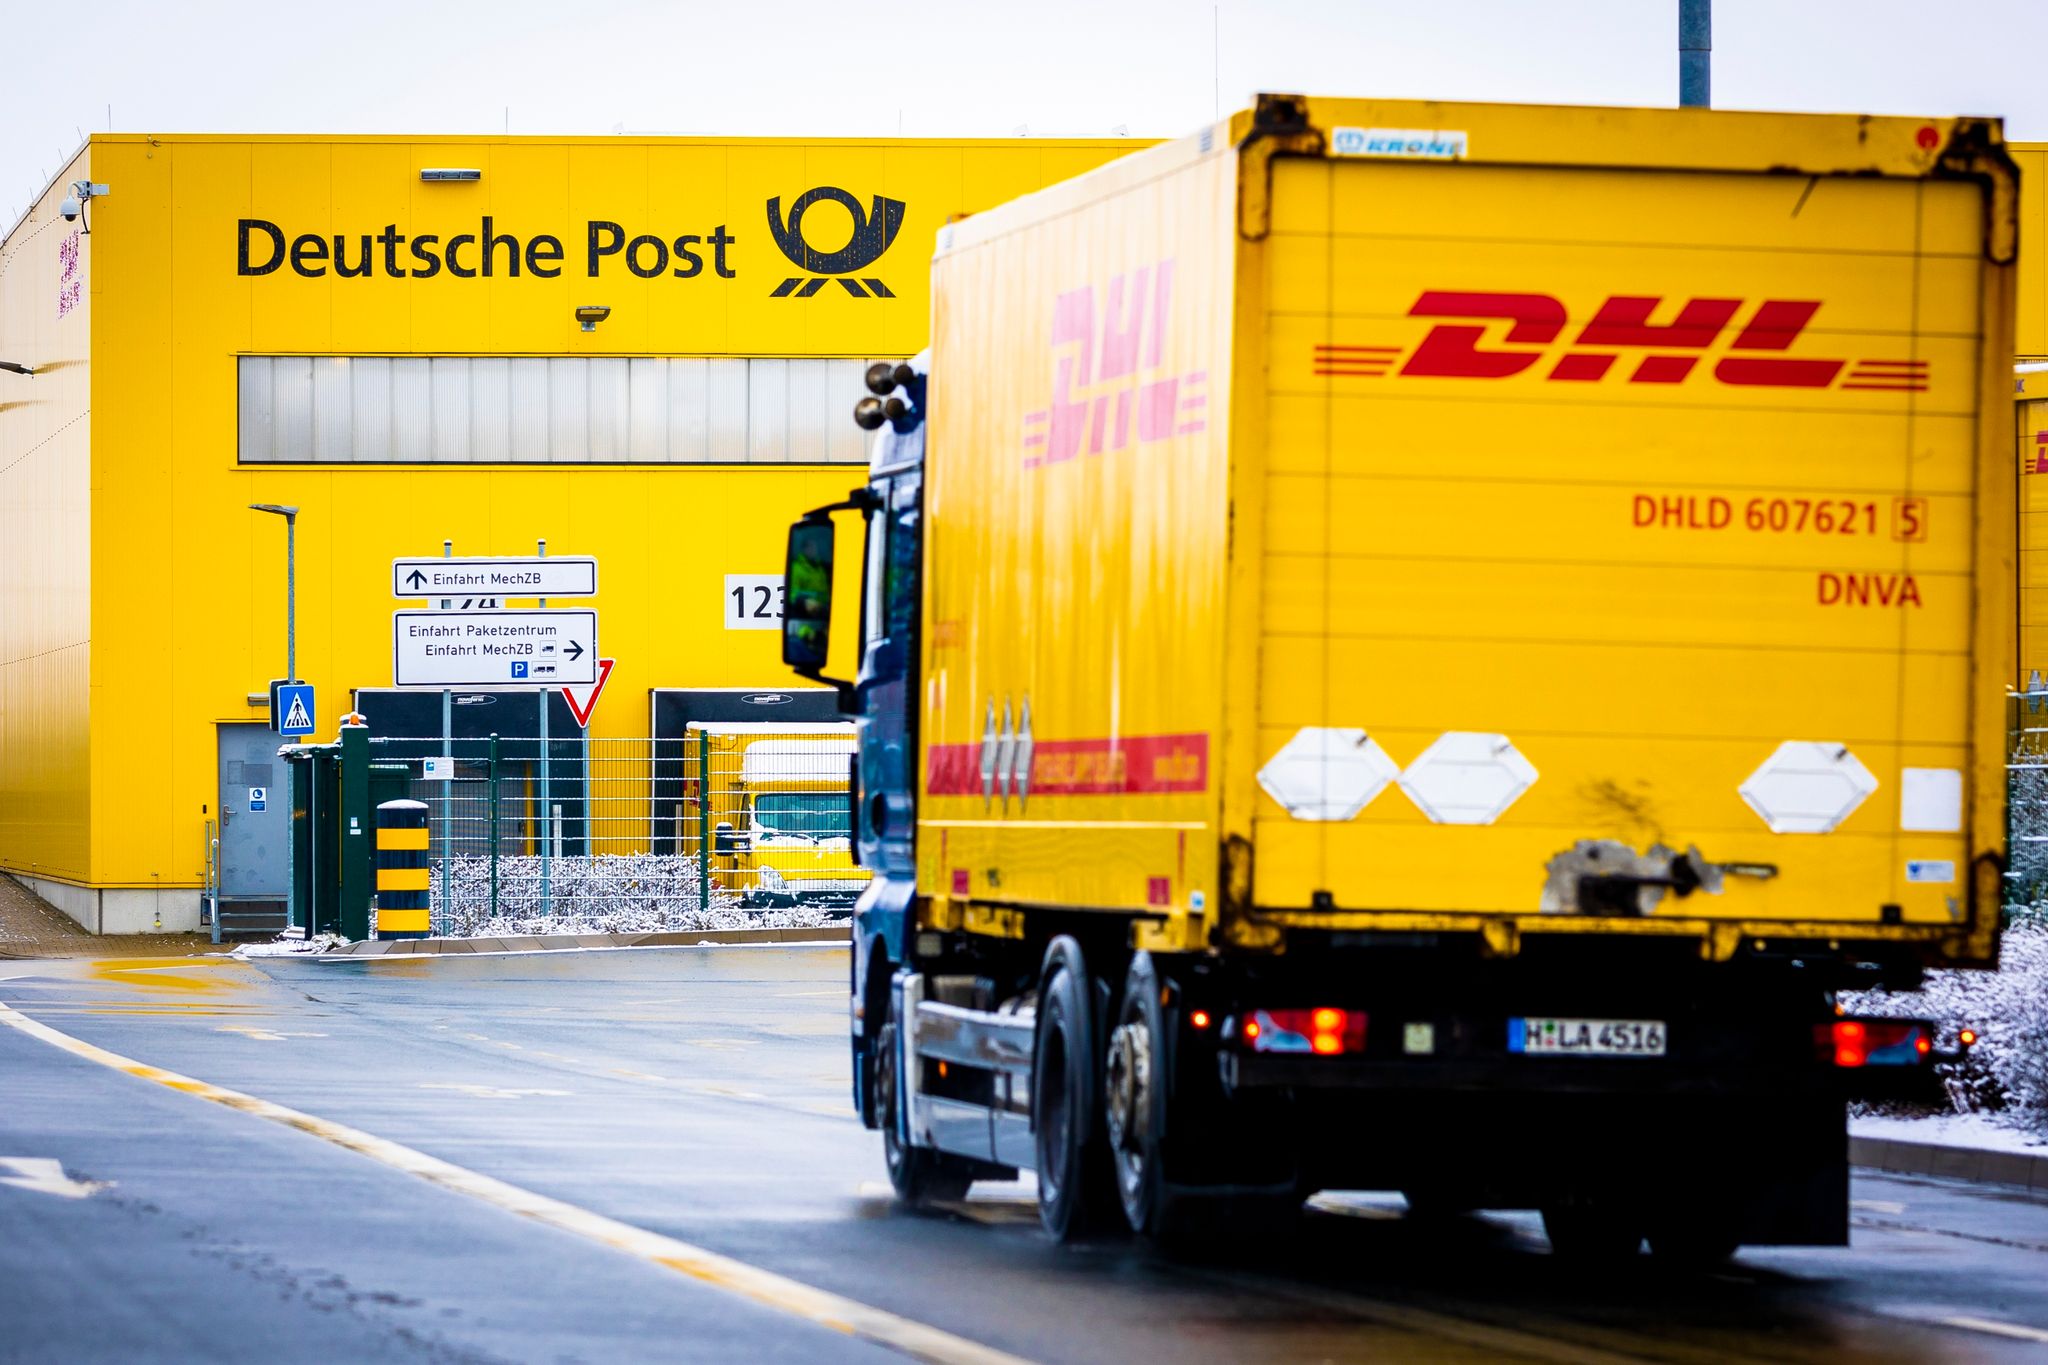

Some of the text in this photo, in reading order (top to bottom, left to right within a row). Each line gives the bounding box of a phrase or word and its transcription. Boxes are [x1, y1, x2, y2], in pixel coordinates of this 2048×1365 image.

[238, 216, 736, 278] Deutsche Post
[1399, 290, 1847, 389] DHL
[1633, 495, 1919, 536] DHLD 607621 5
[433, 572, 541, 585] Einfahrt MechZB
[1818, 572, 1922, 607] DNVA
[409, 624, 557, 637] Einfahrt Paketzentrum
[425, 643, 533, 656] Einfahrt MechZB
[1526, 1023, 1662, 1050] H LA 4516
